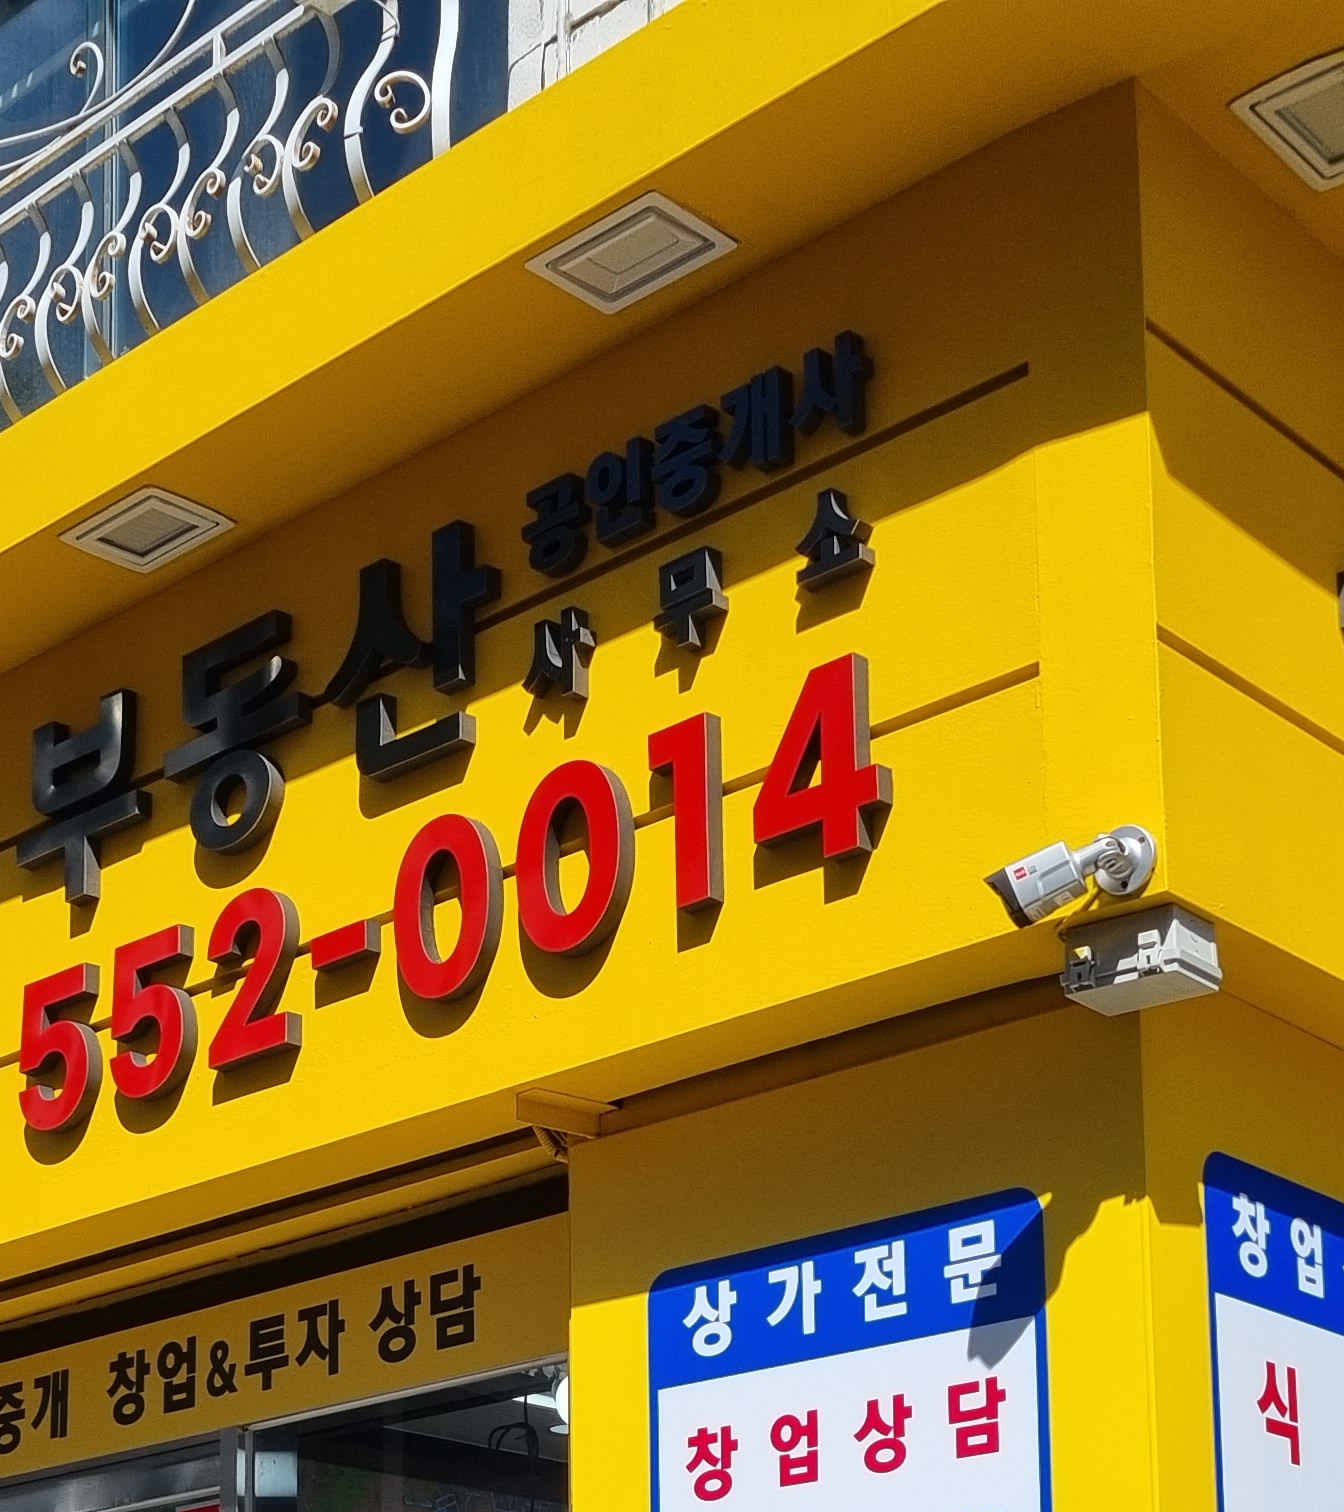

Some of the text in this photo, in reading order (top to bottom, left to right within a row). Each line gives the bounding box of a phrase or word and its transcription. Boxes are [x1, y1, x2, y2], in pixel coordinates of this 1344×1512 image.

[522, 332, 874, 575] 공인중개사
[526, 489, 874, 701] 사무소
[18, 521, 500, 905] 부동산
[19, 652, 891, 1131] 552-0014
[107, 1299, 346, 1425] 창업&투자
[369, 1263, 482, 1363] 상담
[682, 1218, 1003, 1357] 상가전문
[685, 1377, 1007, 1502] 창업상담
